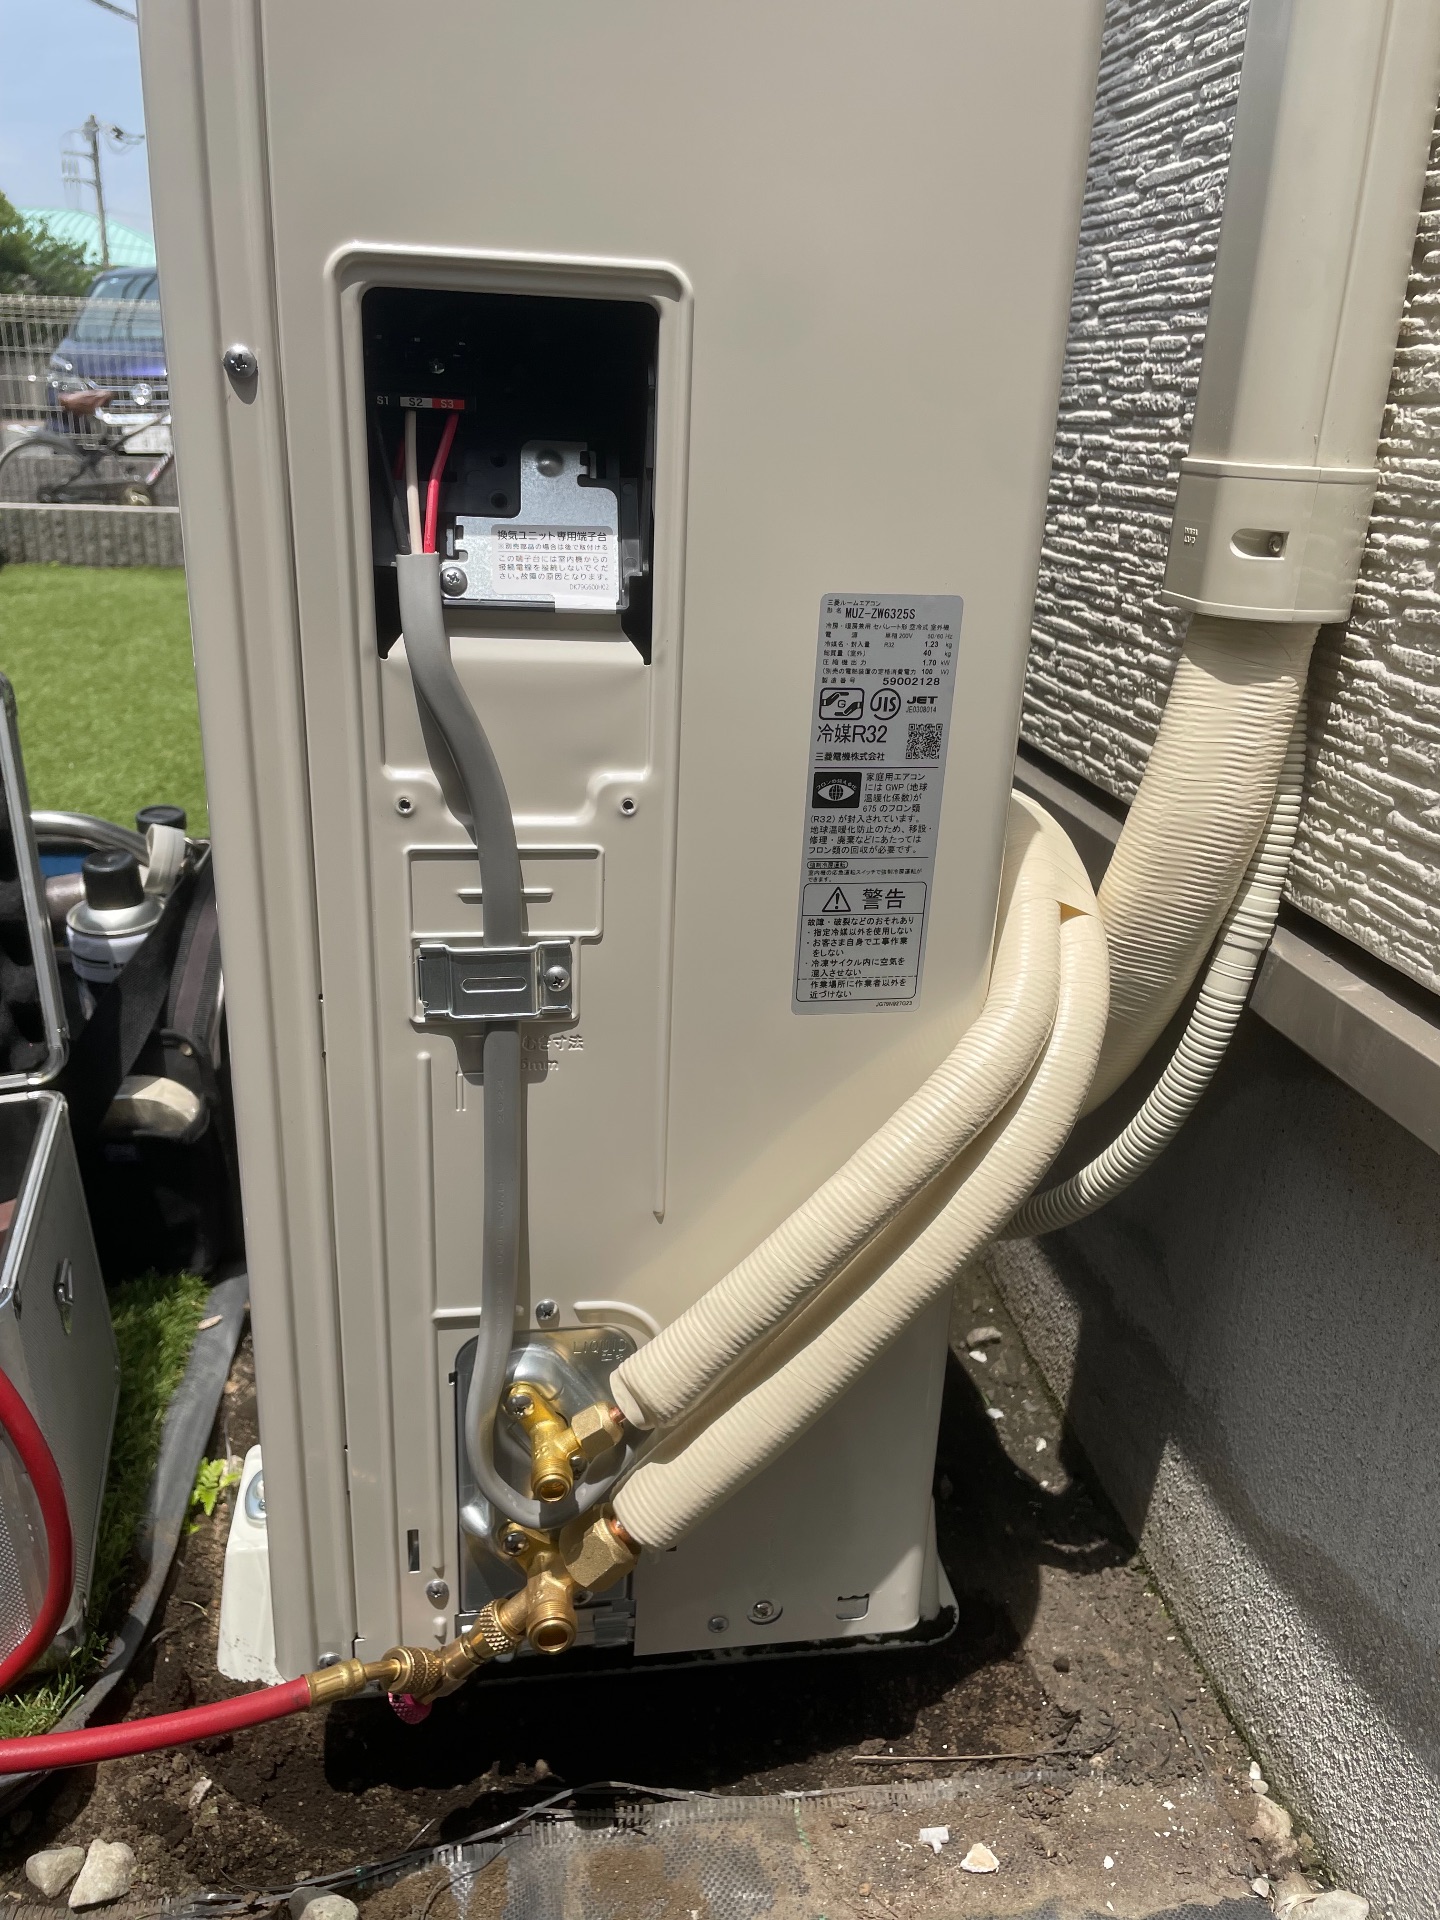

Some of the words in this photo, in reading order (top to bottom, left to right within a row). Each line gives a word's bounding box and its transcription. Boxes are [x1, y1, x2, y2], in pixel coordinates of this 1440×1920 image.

[376, 396, 388, 405] S1
[408, 398, 423, 406] S2
[440, 400, 454, 408] S3
[498, 530, 607, 542] 換気ユニット専用端子台
[498, 555, 608, 563] この端子台には室内機からの
[498, 564, 608, 572] 接続電線を接続しないでくだ
[845, 608, 916, 619] MUZ-ZW6325S
[882, 677, 940, 686] 59002128
[872, 696, 897, 712] JIS
[906, 696, 938, 704] JET
[816, 724, 888, 744] 冷媒R32
[815, 752, 885, 761] 三菱電機株式会社
[866, 773, 926, 781] 家庭用エアコン
[865, 783, 882, 792] には
[880, 804, 921, 813] のフロン類
[810, 815, 835, 823] (R32)
[838, 814, 920, 823] が封入されています。
[810, 825, 932, 834] 地球温暖化防止のため、移設・
[809, 835, 922, 845] 修理・廃棄などにあたっては
[809, 845, 917, 854] フロン類の回収が必要です。
[862, 888, 906, 910] 警告
[808, 917, 914, 927] 故障・破裂などのおそれあり
[812, 948, 844, 957] をしない
[811, 968, 862, 977] 混入させない
[810, 979, 906, 989] 作業場所に作業者以外を
[810, 991, 852, 999] 近づけない
[573, 1339, 627, 1354] LIQUID
